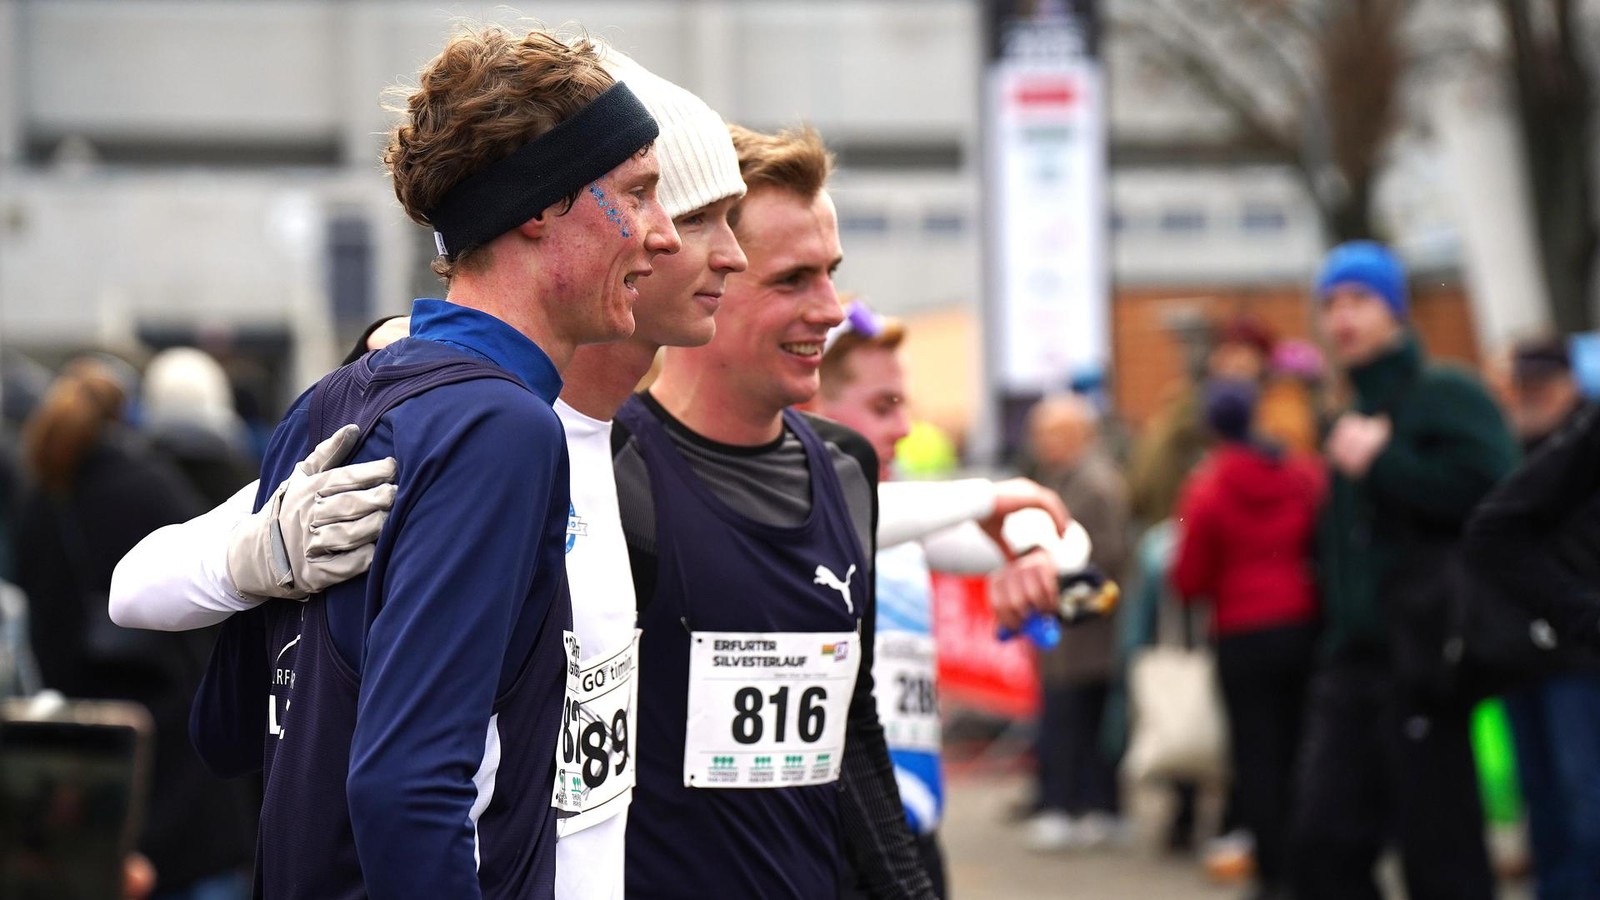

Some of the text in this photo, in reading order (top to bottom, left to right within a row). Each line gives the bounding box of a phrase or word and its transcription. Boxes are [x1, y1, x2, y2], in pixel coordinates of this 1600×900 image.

[712, 656, 808, 668] SILVESTERLAUF
[713, 640, 777, 651] ERFURTER
[582, 669, 605, 692] GO
[610, 654, 633, 680] timin
[731, 686, 828, 745] 816
[581, 708, 629, 788] 89
